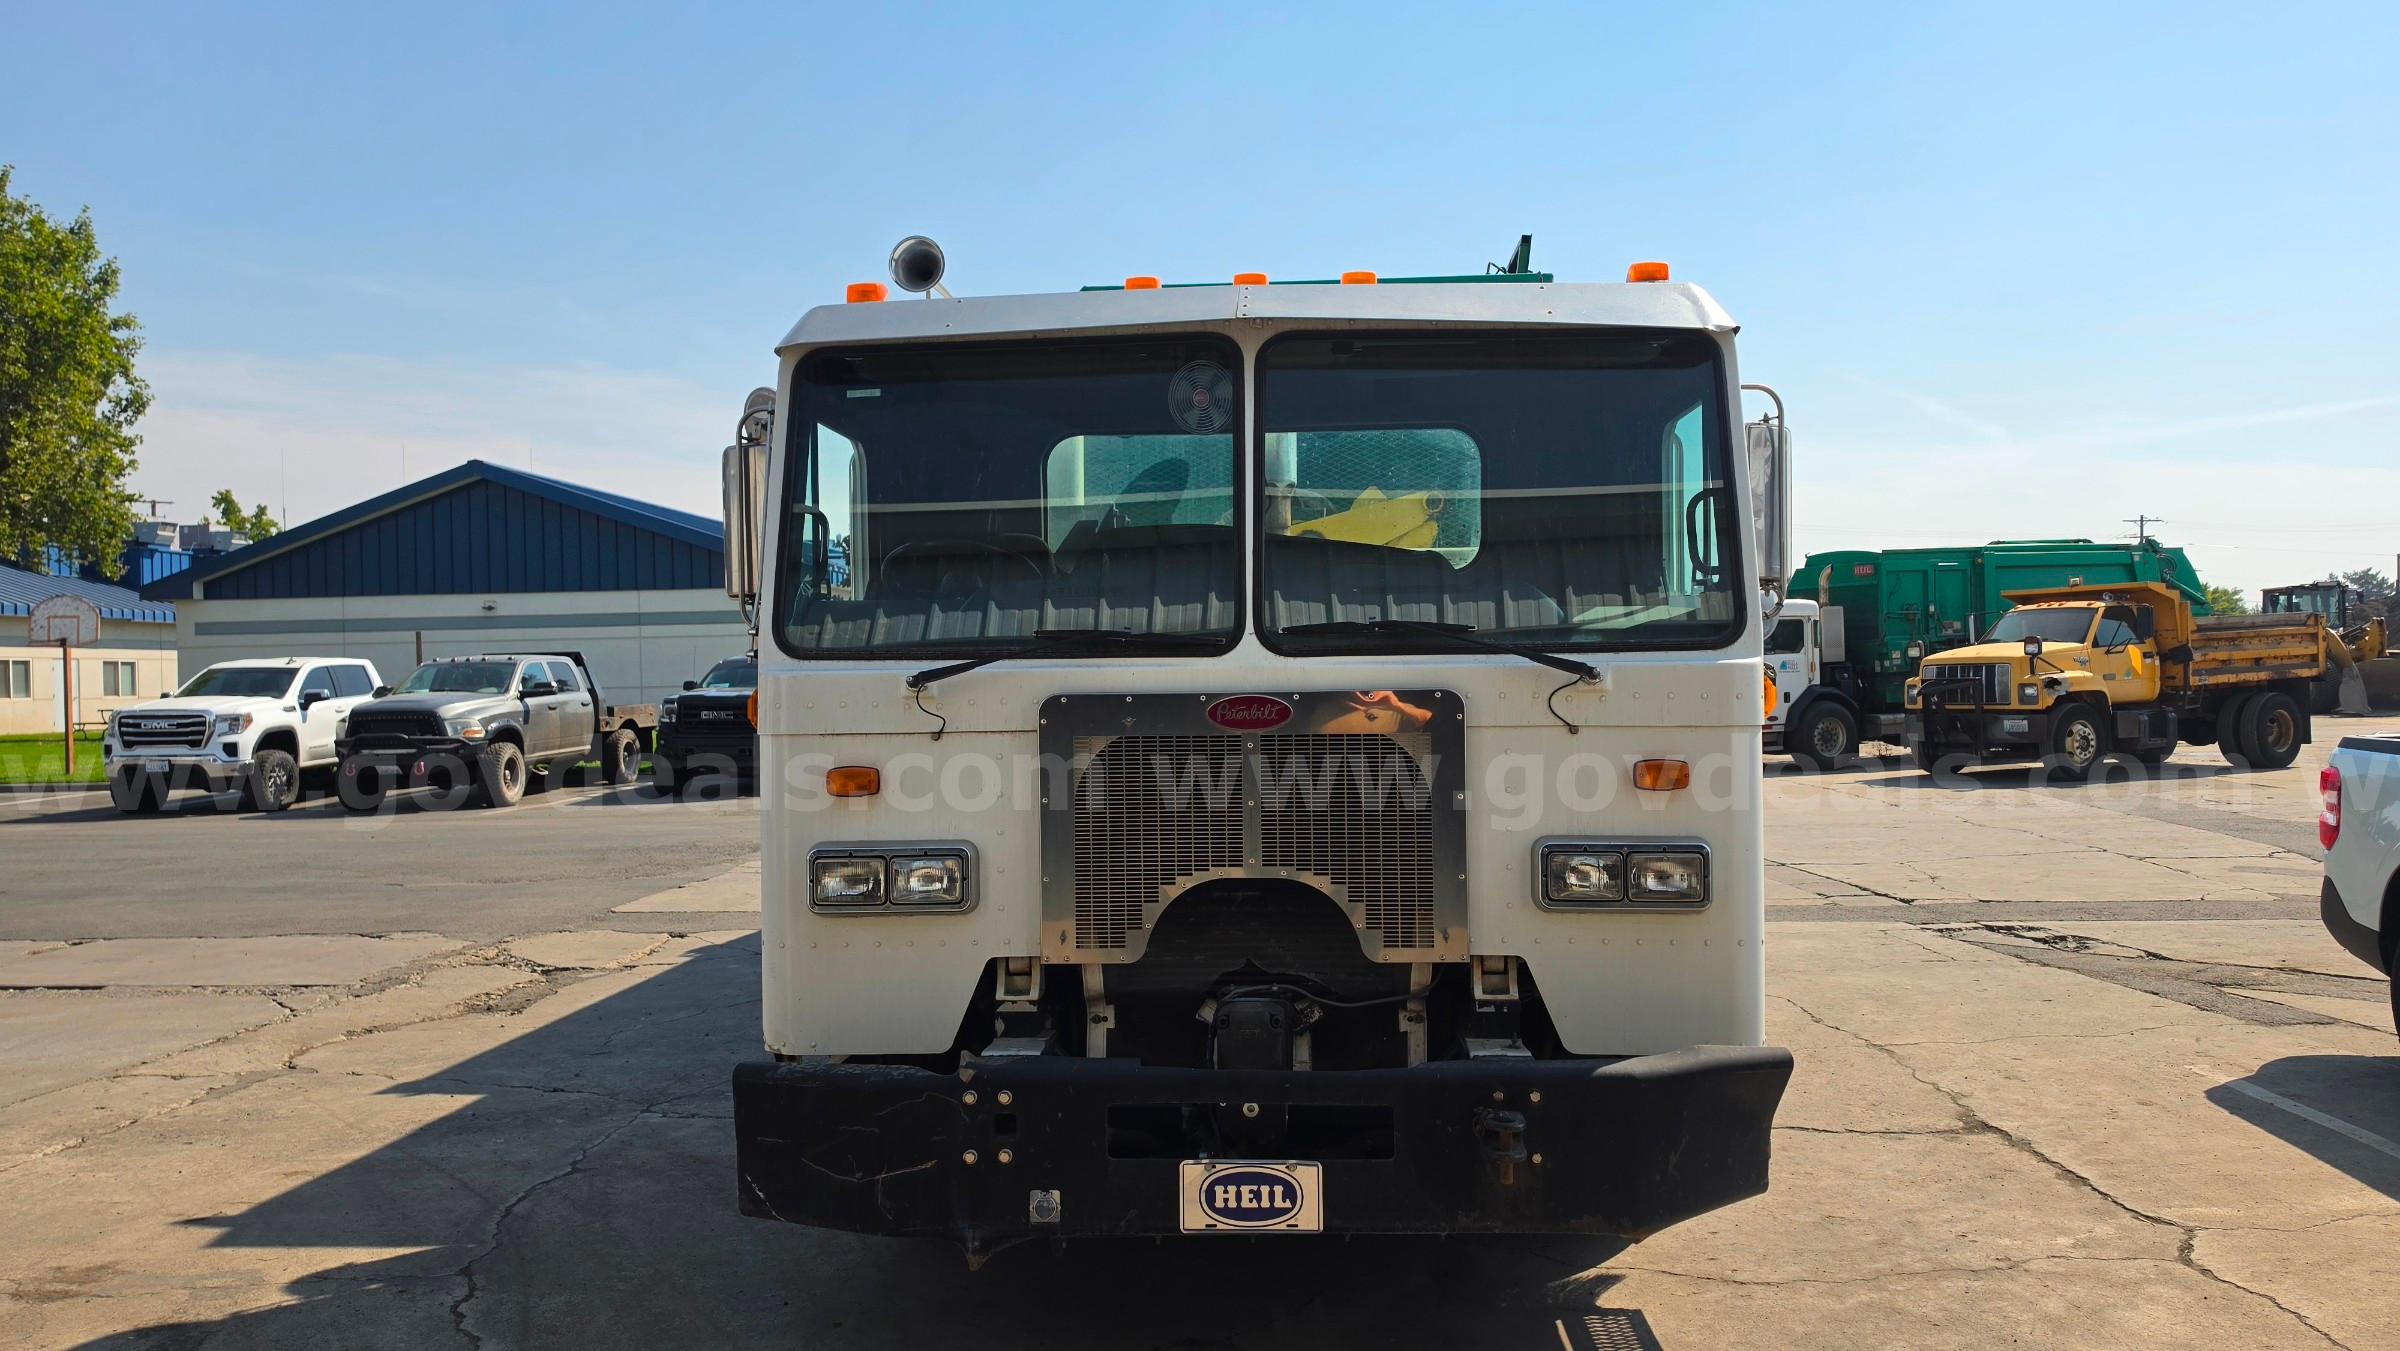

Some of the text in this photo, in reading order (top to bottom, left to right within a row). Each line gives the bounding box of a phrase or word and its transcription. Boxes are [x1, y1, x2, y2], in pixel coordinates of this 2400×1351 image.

[701, 710, 734, 719] GMC
[1216, 702, 1284, 722] Peterbilt
[141, 720, 177, 729] GMC
[1214, 1185, 1293, 1209] HEIL
